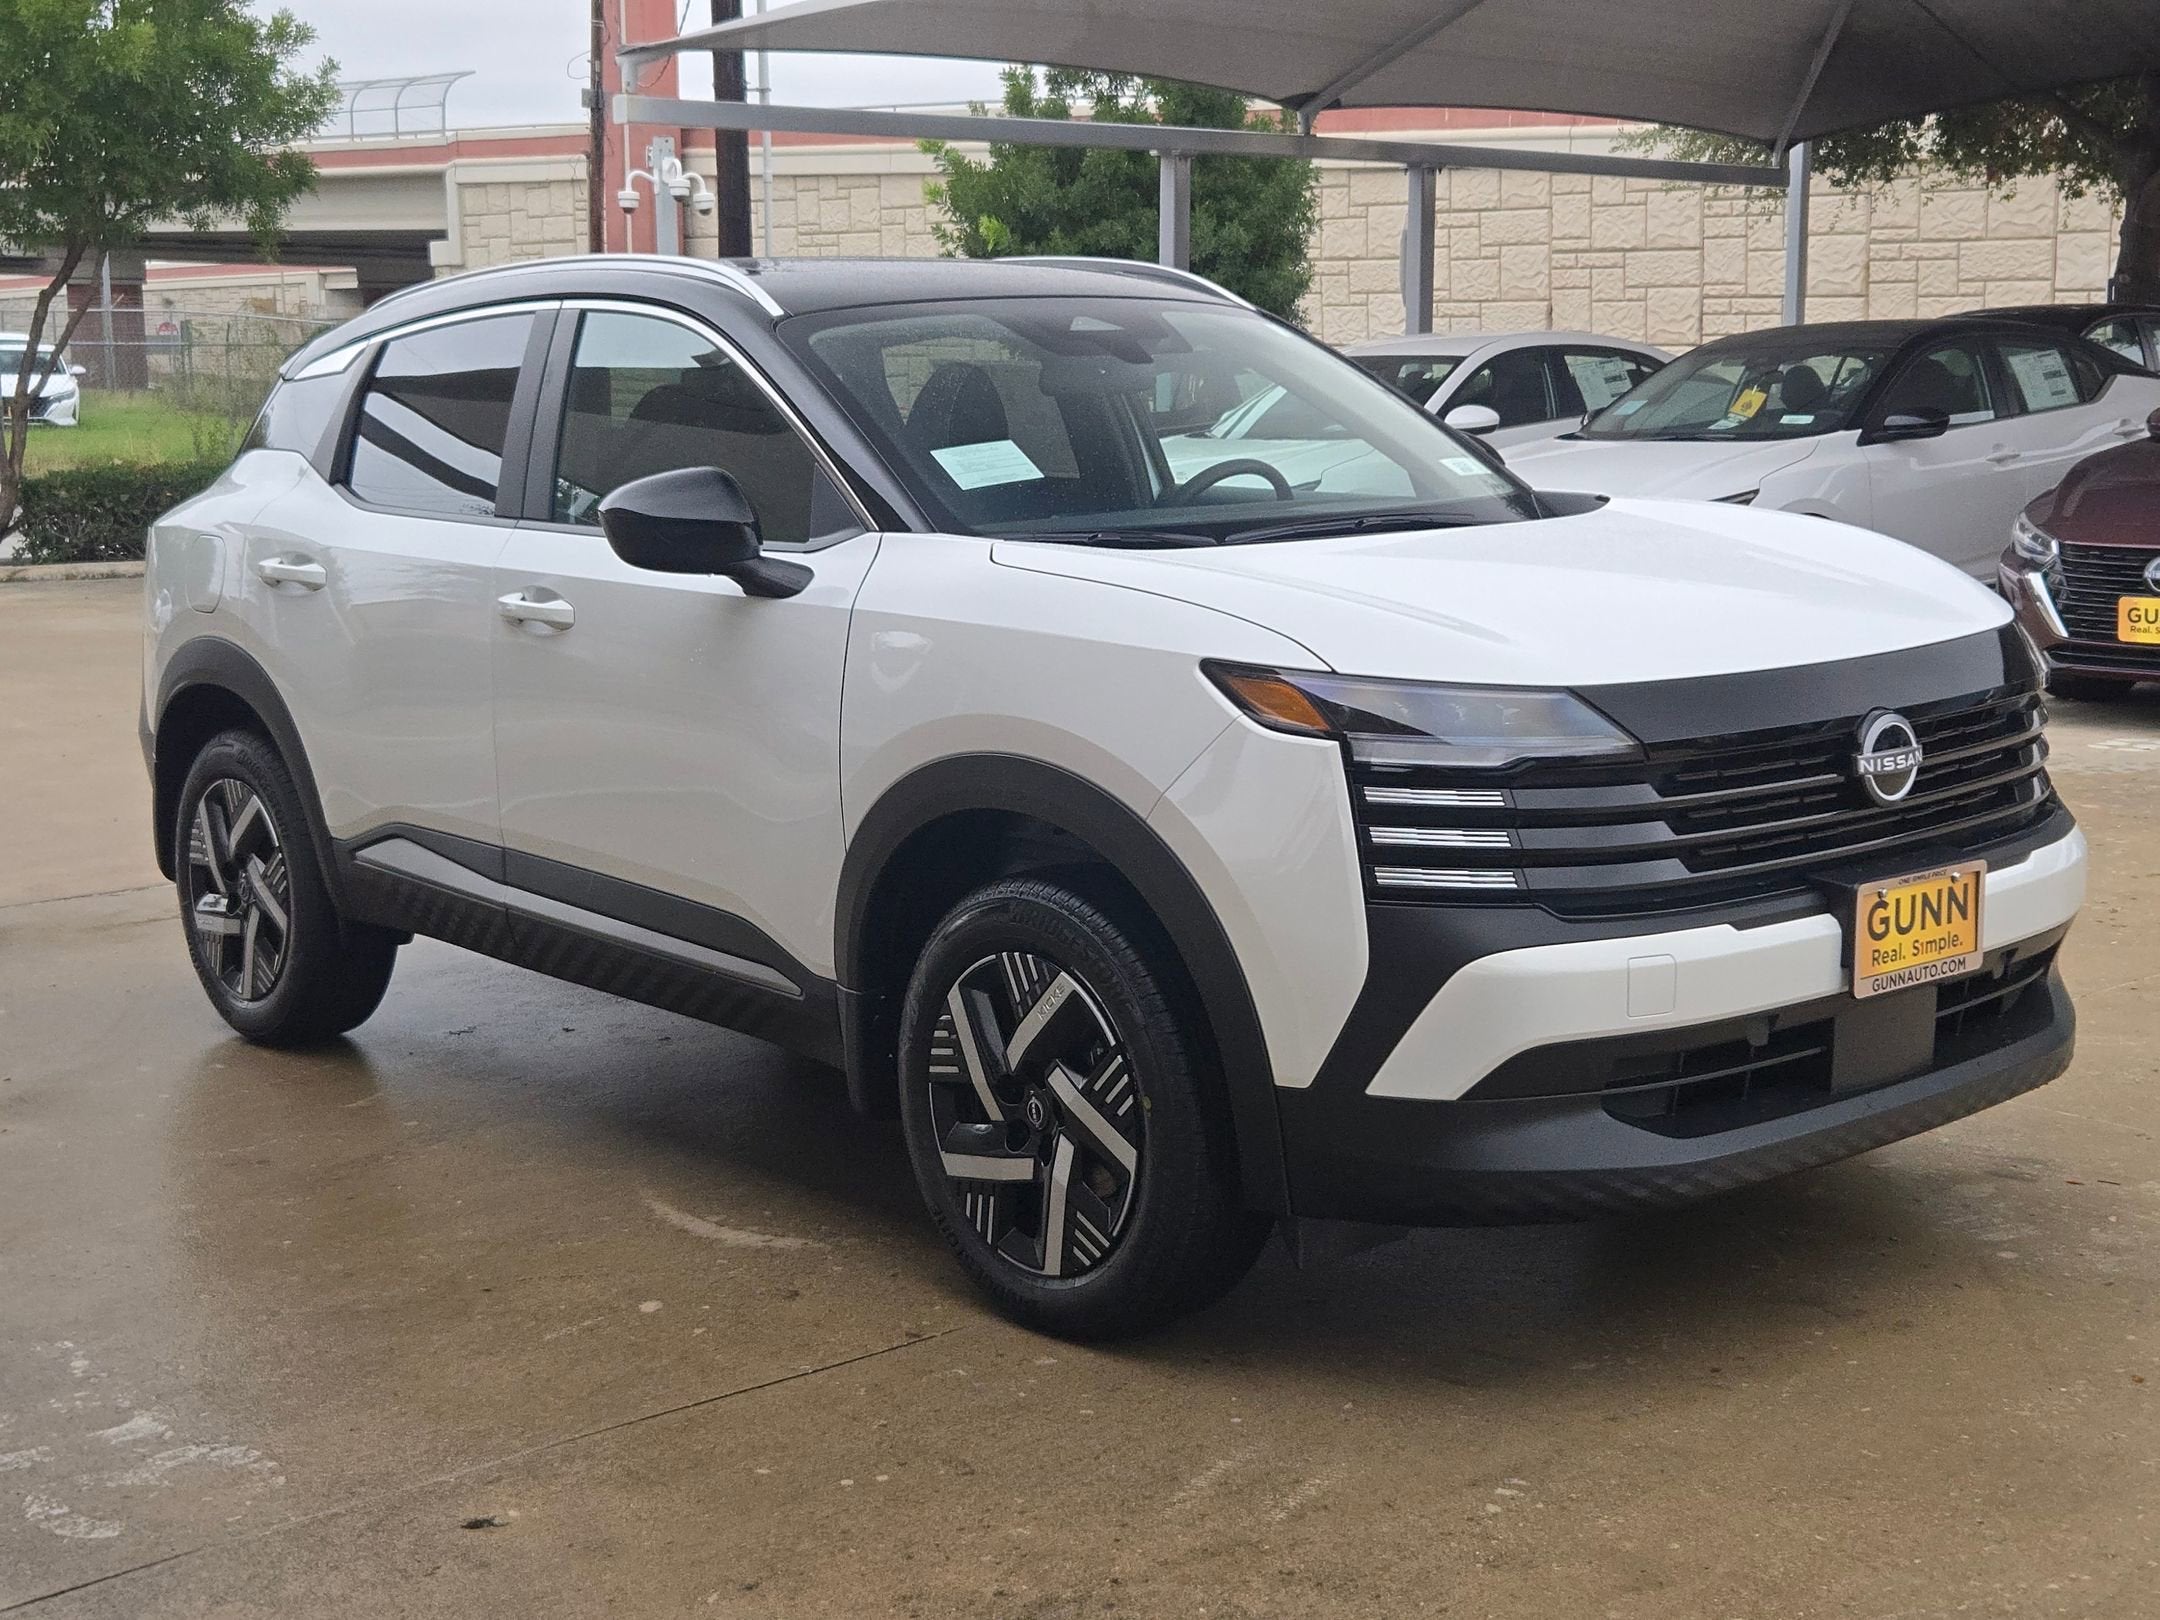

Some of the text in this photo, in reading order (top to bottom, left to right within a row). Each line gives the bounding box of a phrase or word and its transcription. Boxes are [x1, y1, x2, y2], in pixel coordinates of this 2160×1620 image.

[2130, 625, 2153, 634] Real.
[1859, 748, 1923, 774] NISSAN
[1867, 882, 1969, 941] GUNN
[1871, 942, 1907, 967] Real.
[1872, 956, 1967, 993] GUNNAUTO.COM
